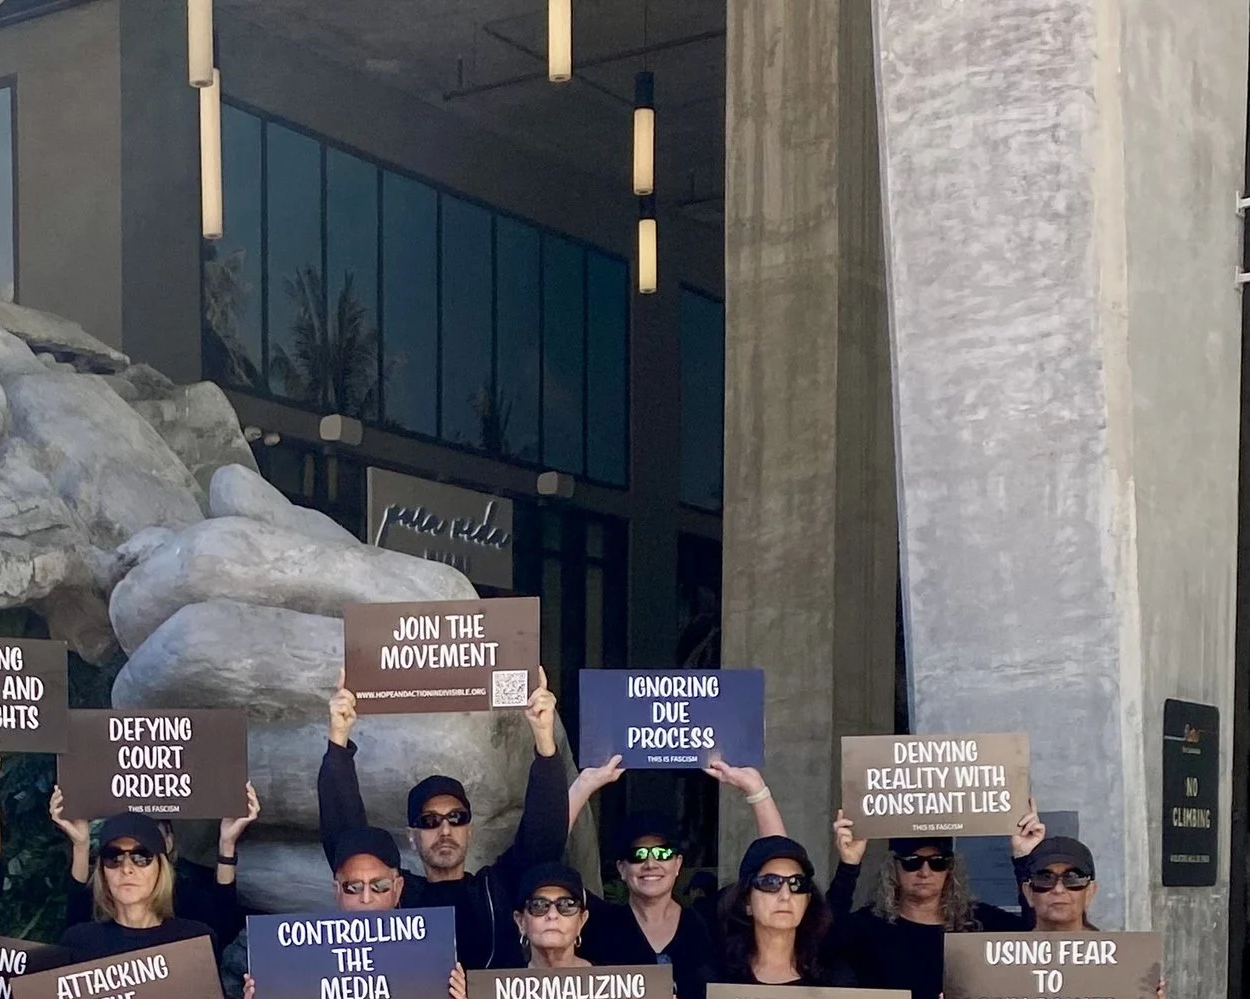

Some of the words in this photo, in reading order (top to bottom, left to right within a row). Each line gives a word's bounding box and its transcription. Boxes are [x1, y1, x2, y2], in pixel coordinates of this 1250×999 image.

[393, 615, 440, 641] JOIN
[445, 614, 485, 639] THE
[381, 642, 499, 670] MOVEMENT
[2, 675, 44, 701] AND
[628, 676, 719, 698] IGNORING
[653, 701, 690, 723] DUE
[109, 717, 192, 741] DEFYING
[628, 727, 715, 749] PROCESS
[118, 745, 184, 769] COURT
[647, 755, 662, 763] THIS
[670, 755, 698, 763] FASCISM
[894, 740, 978, 764] DENYING
[111, 774, 191, 797] ORDERS
[867, 766, 949, 790] REALITY
[954, 765, 1005, 788] WITH
[1186, 777, 1199, 797] NO
[128, 805, 143, 813] THIS
[862, 791, 966, 816] CONSTANT
[971, 790, 1011, 813] LIES
[1172, 807, 1211, 829] CLIMBING
[278, 916, 425, 946] CONTROLLING
[331, 947, 375, 973] THE
[986, 941, 1052, 965] USING
[1059, 941, 1117, 965] FEAR
[1032, 969, 1063, 993] TO
